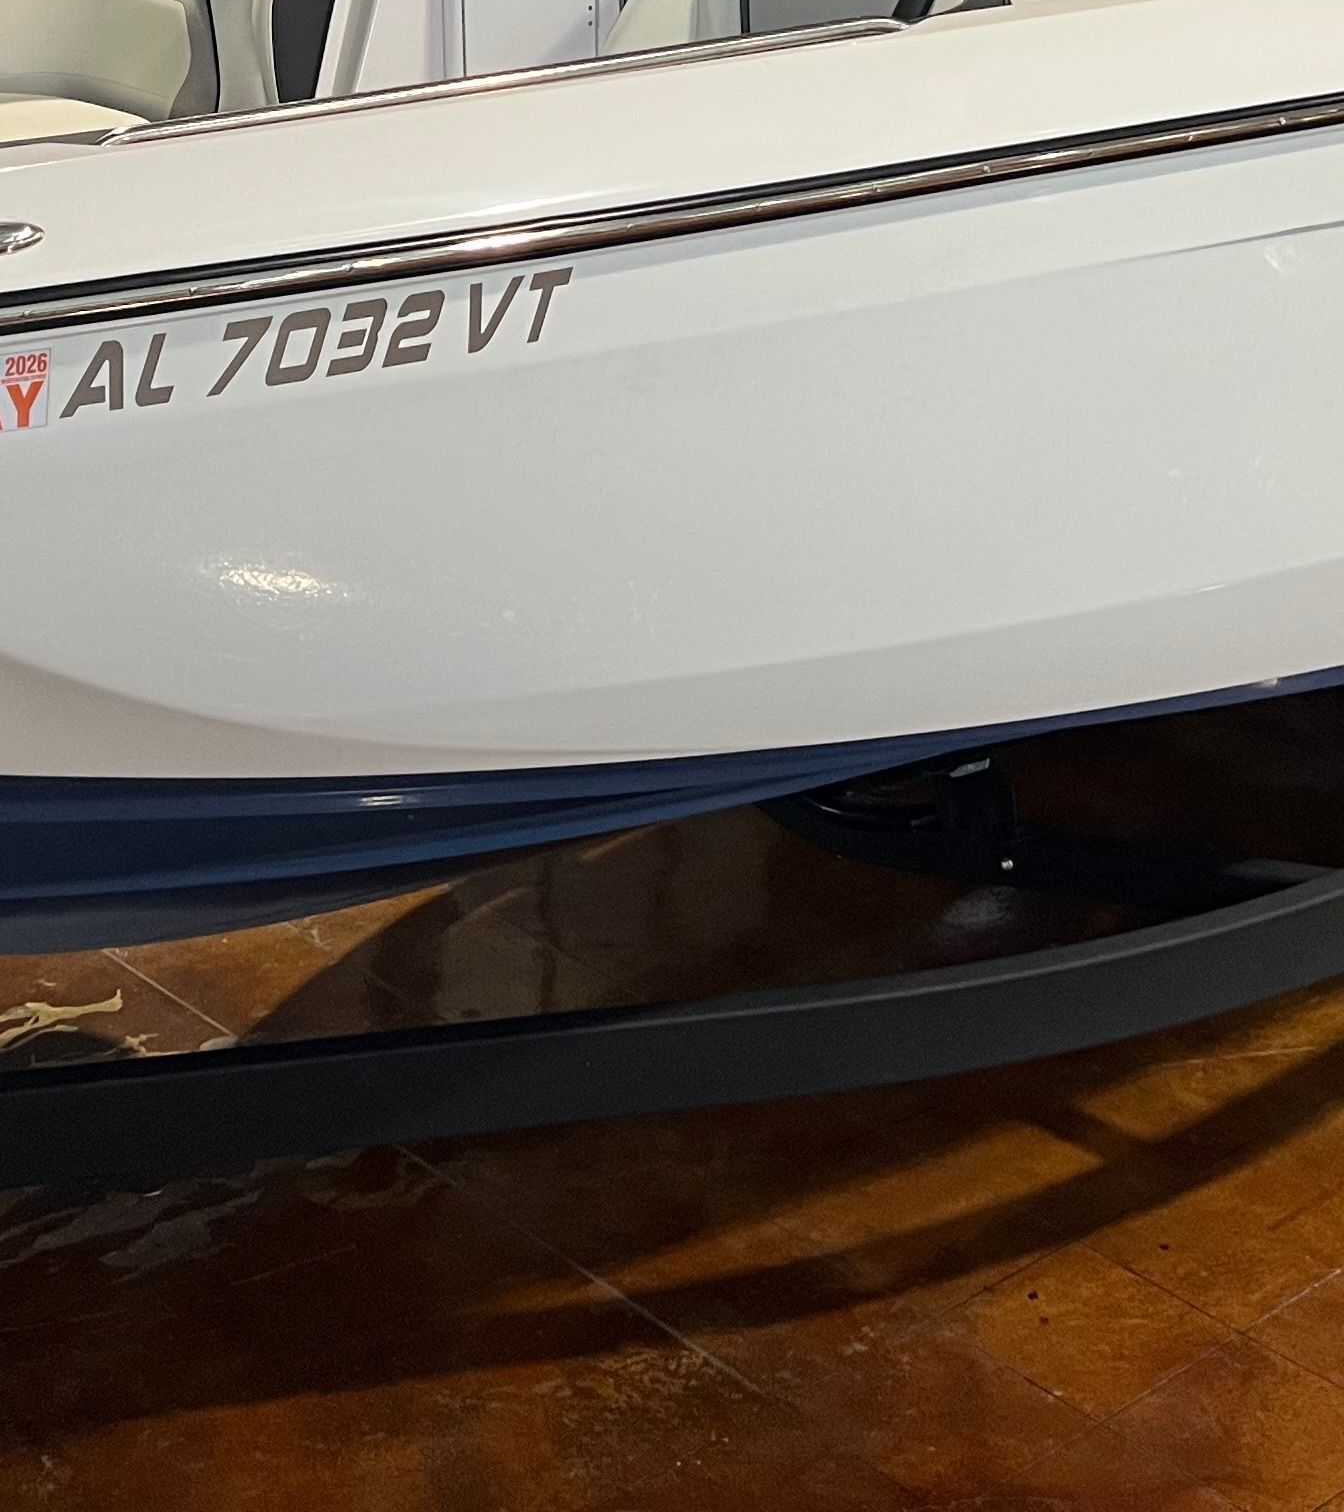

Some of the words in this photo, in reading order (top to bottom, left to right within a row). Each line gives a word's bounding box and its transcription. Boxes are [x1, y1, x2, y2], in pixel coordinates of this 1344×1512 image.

[5, 353, 48, 377] 2026
[59, 333, 175, 419] AL
[206, 289, 446, 397] 7032
[467, 266, 574, 355] VT
